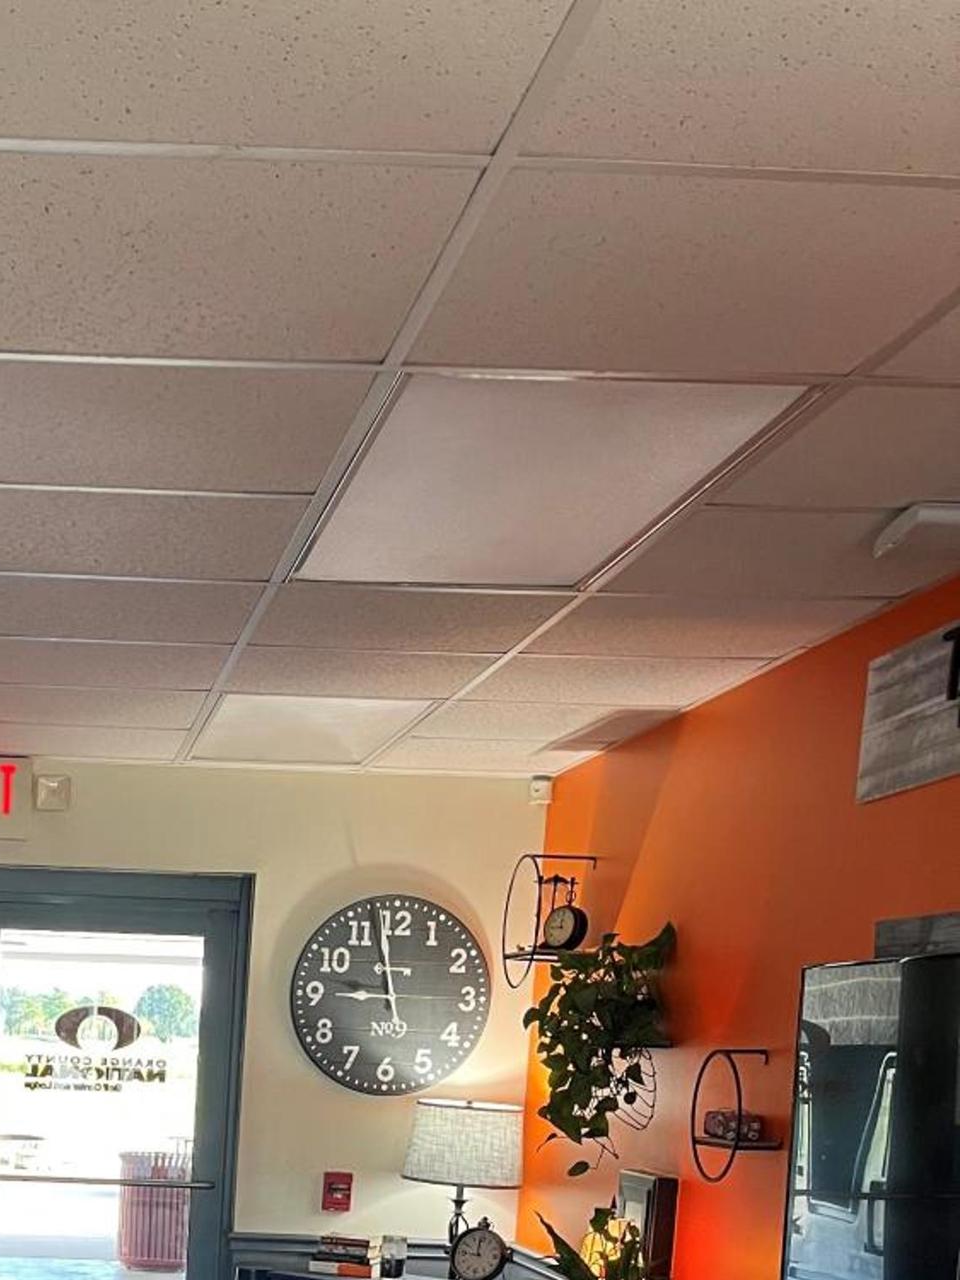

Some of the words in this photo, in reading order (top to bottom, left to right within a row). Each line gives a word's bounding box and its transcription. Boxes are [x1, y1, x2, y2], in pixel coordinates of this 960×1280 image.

[347, 921, 372, 947] 11
[382, 910, 412, 936] 12
[425, 921, 438, 947] 1
[319, 947, 350, 973] 10
[449, 948, 468, 974] 2
[305, 981, 325, 1007] 9
[458, 986, 476, 1012] 3
[315, 1018, 333, 1044] 8
[440, 1022, 461, 1048] 4
[343, 1046, 360, 1071] 7
[376, 1057, 394, 1082] 6
[414, 1050, 433, 1074] 5
